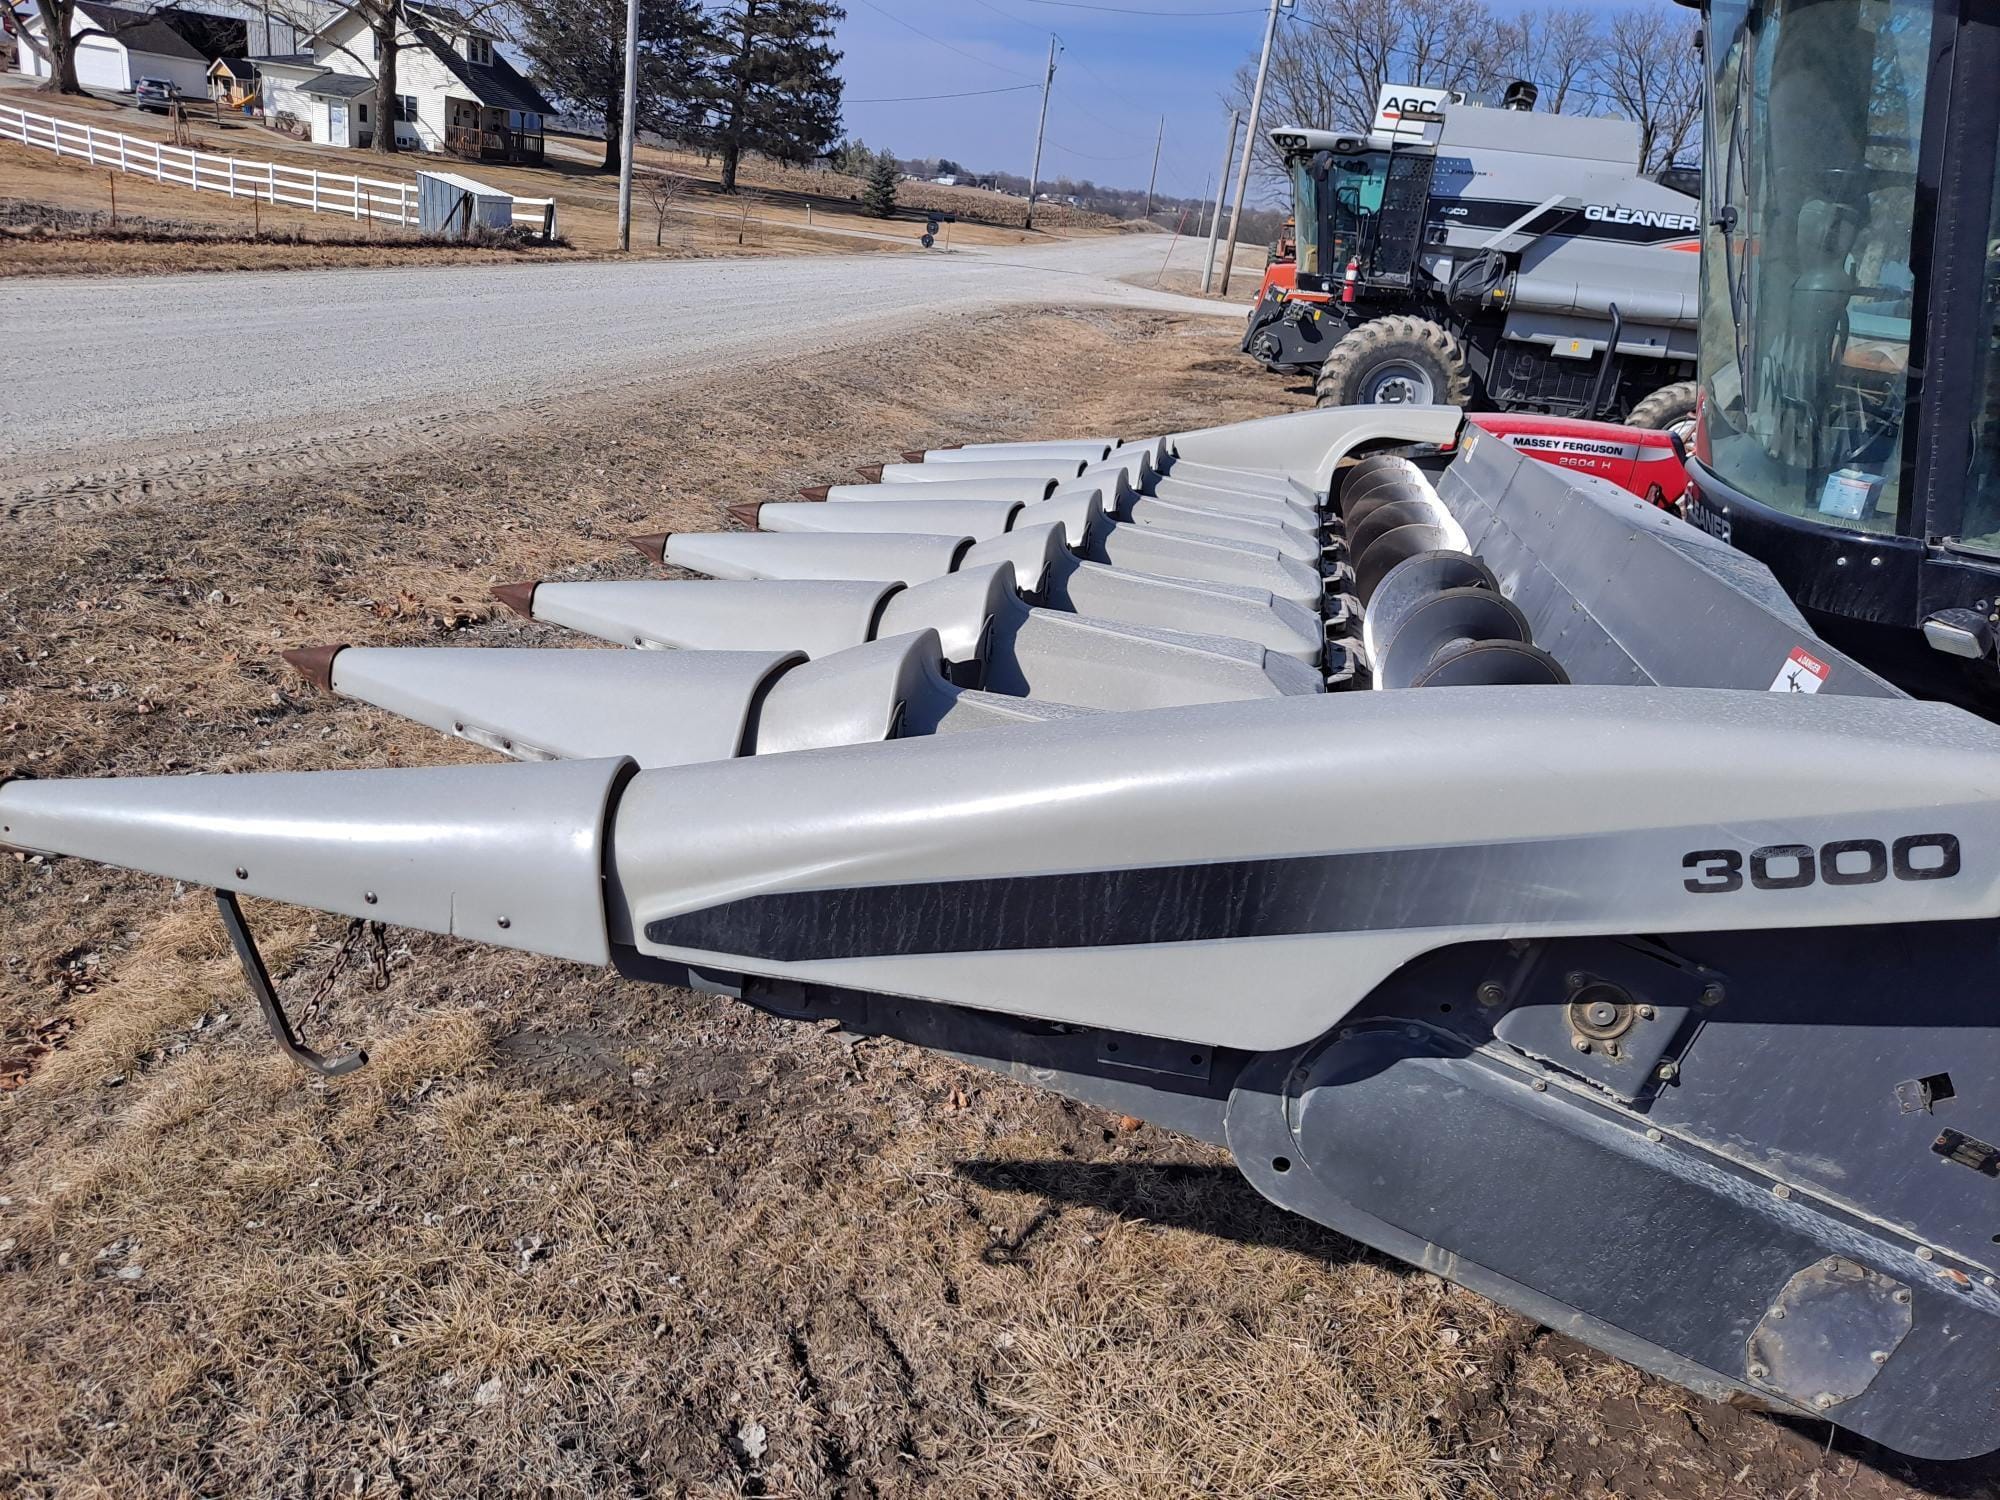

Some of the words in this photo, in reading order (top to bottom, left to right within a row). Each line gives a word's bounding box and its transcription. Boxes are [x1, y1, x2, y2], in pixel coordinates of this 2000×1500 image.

[1382, 97, 1437, 113] AGC
[1584, 205, 1697, 231] GLEANER
[1513, 437, 1560, 449] MASSEY
[1562, 441, 1623, 456] FERGUSON
[1559, 457, 1595, 468] 2604
[1601, 461, 1612, 470] H
[1682, 833, 1961, 893] 3000
